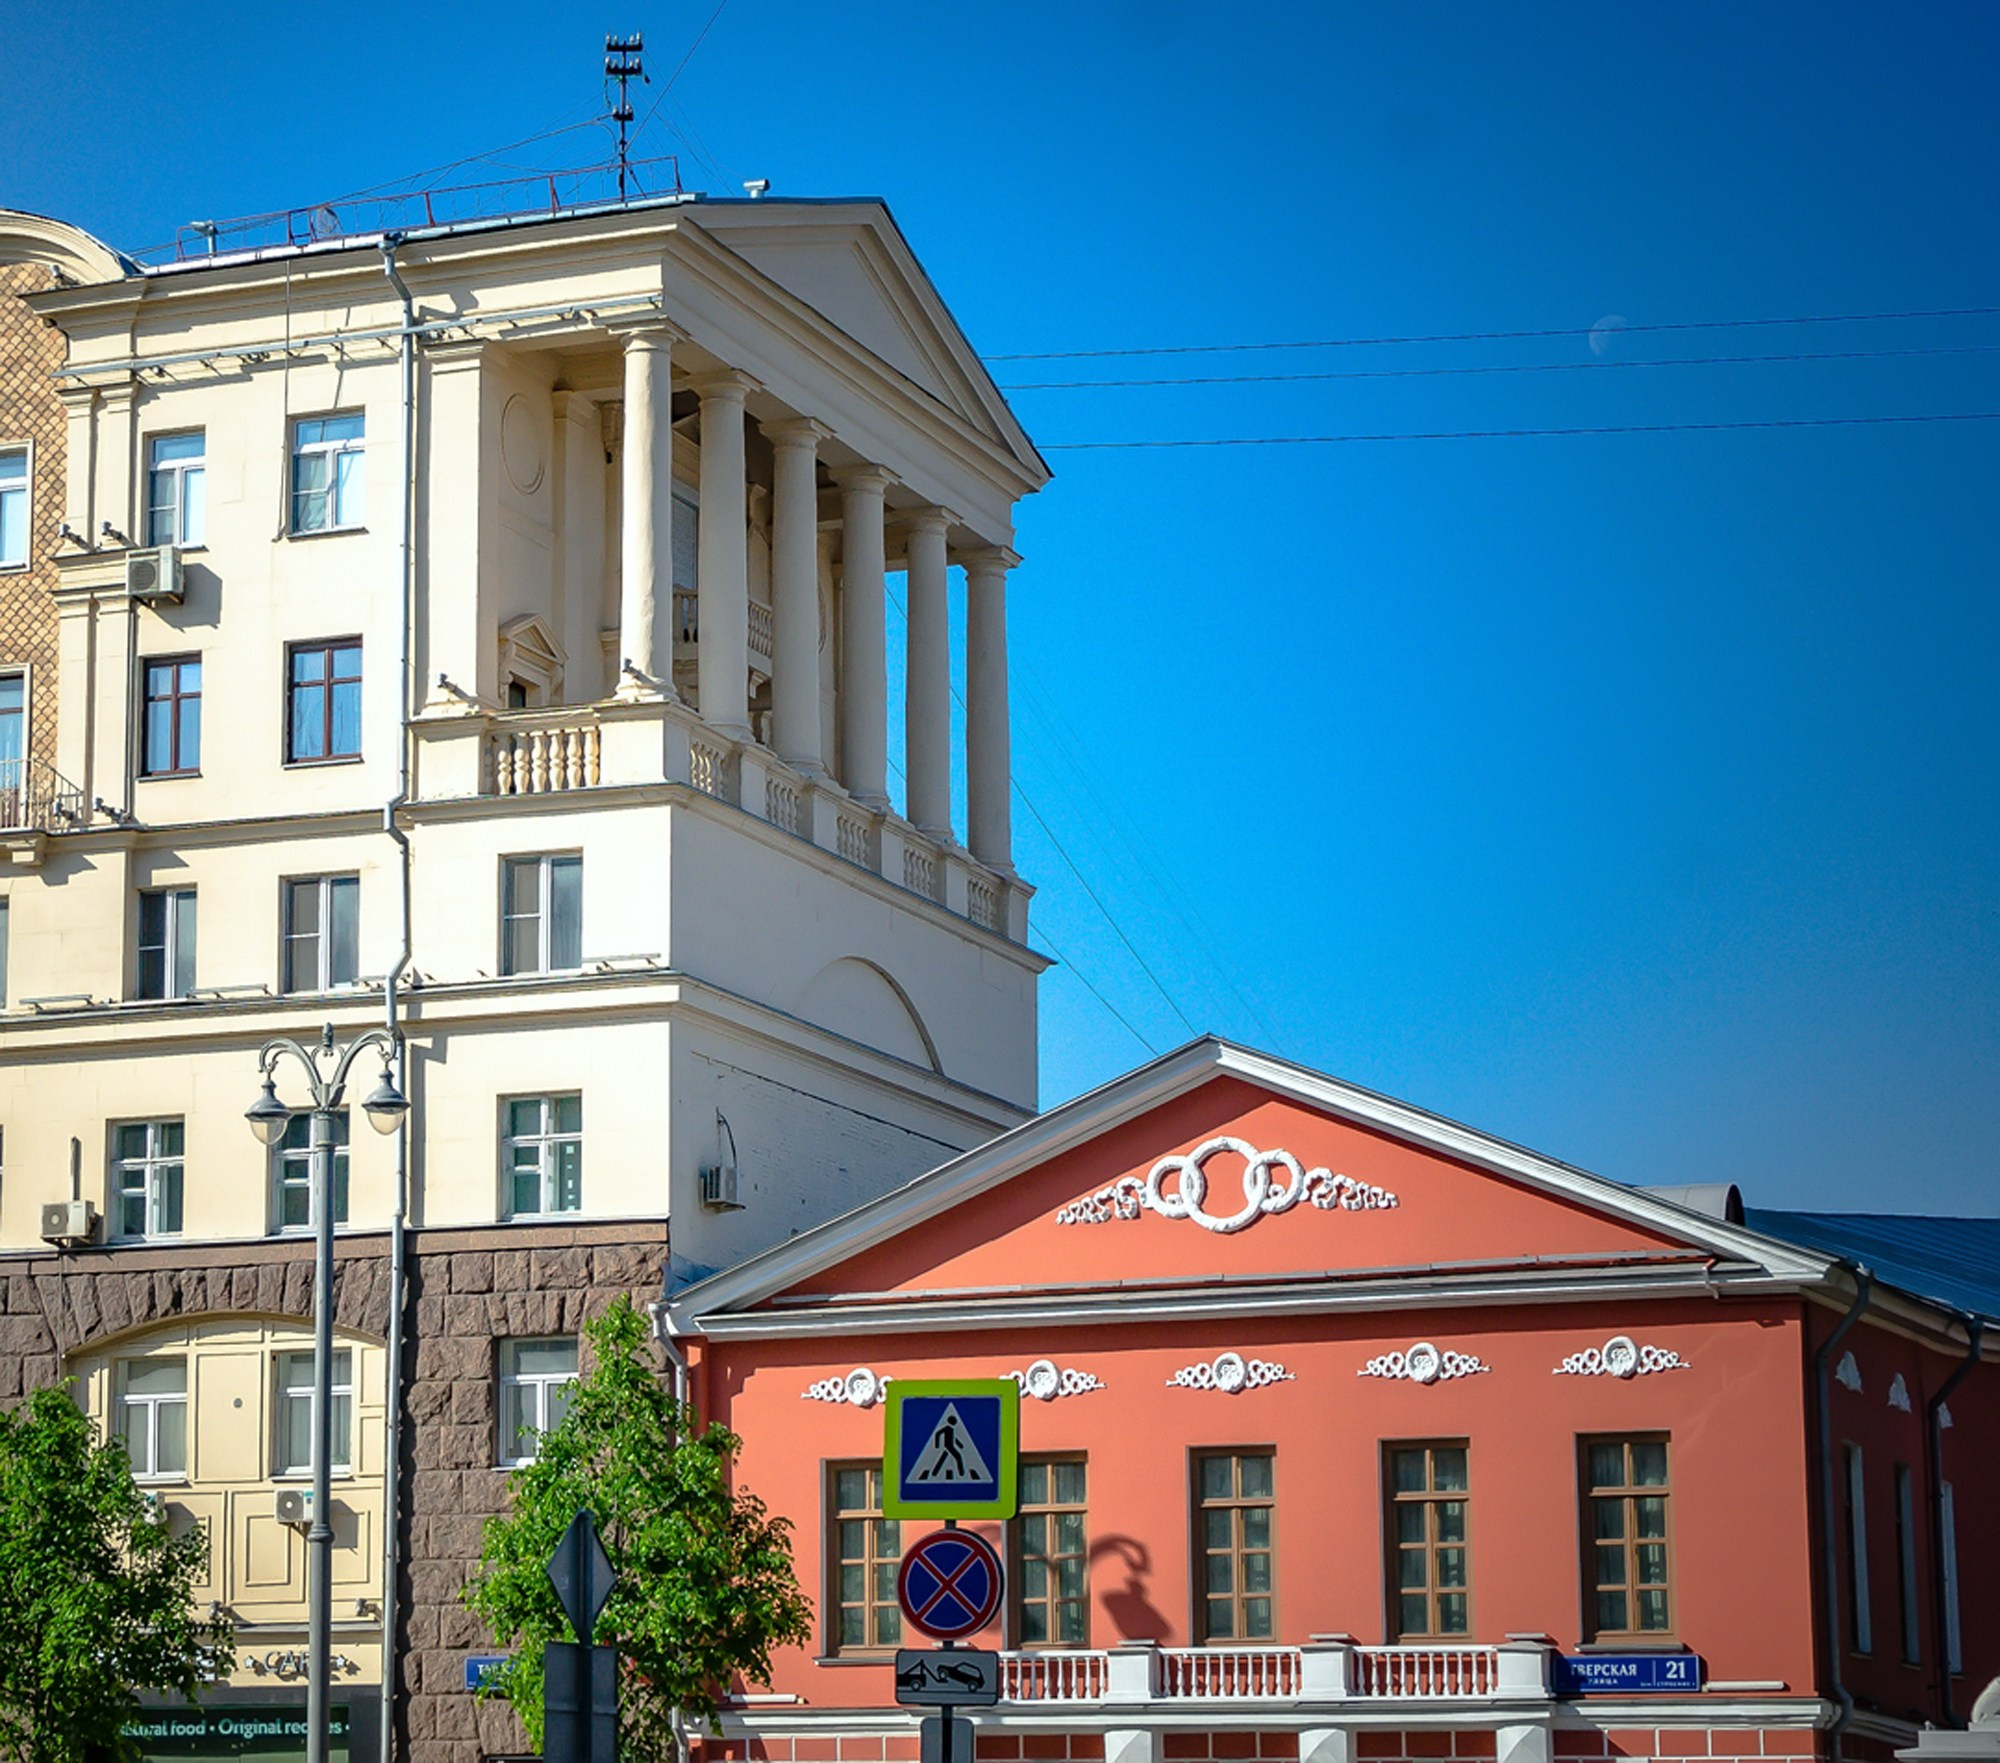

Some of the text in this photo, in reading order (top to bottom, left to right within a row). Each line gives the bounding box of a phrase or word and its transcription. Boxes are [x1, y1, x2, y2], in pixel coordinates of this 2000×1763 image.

[264, 1650, 310, 1672] CAF
[1571, 1663, 1638, 1677] ТВЕРСКАЯ
[1666, 1660, 1686, 1679] 21
[170, 1720, 206, 1735] food
[218, 1718, 282, 1739] Original
[284, 1722, 342, 1735] reces
